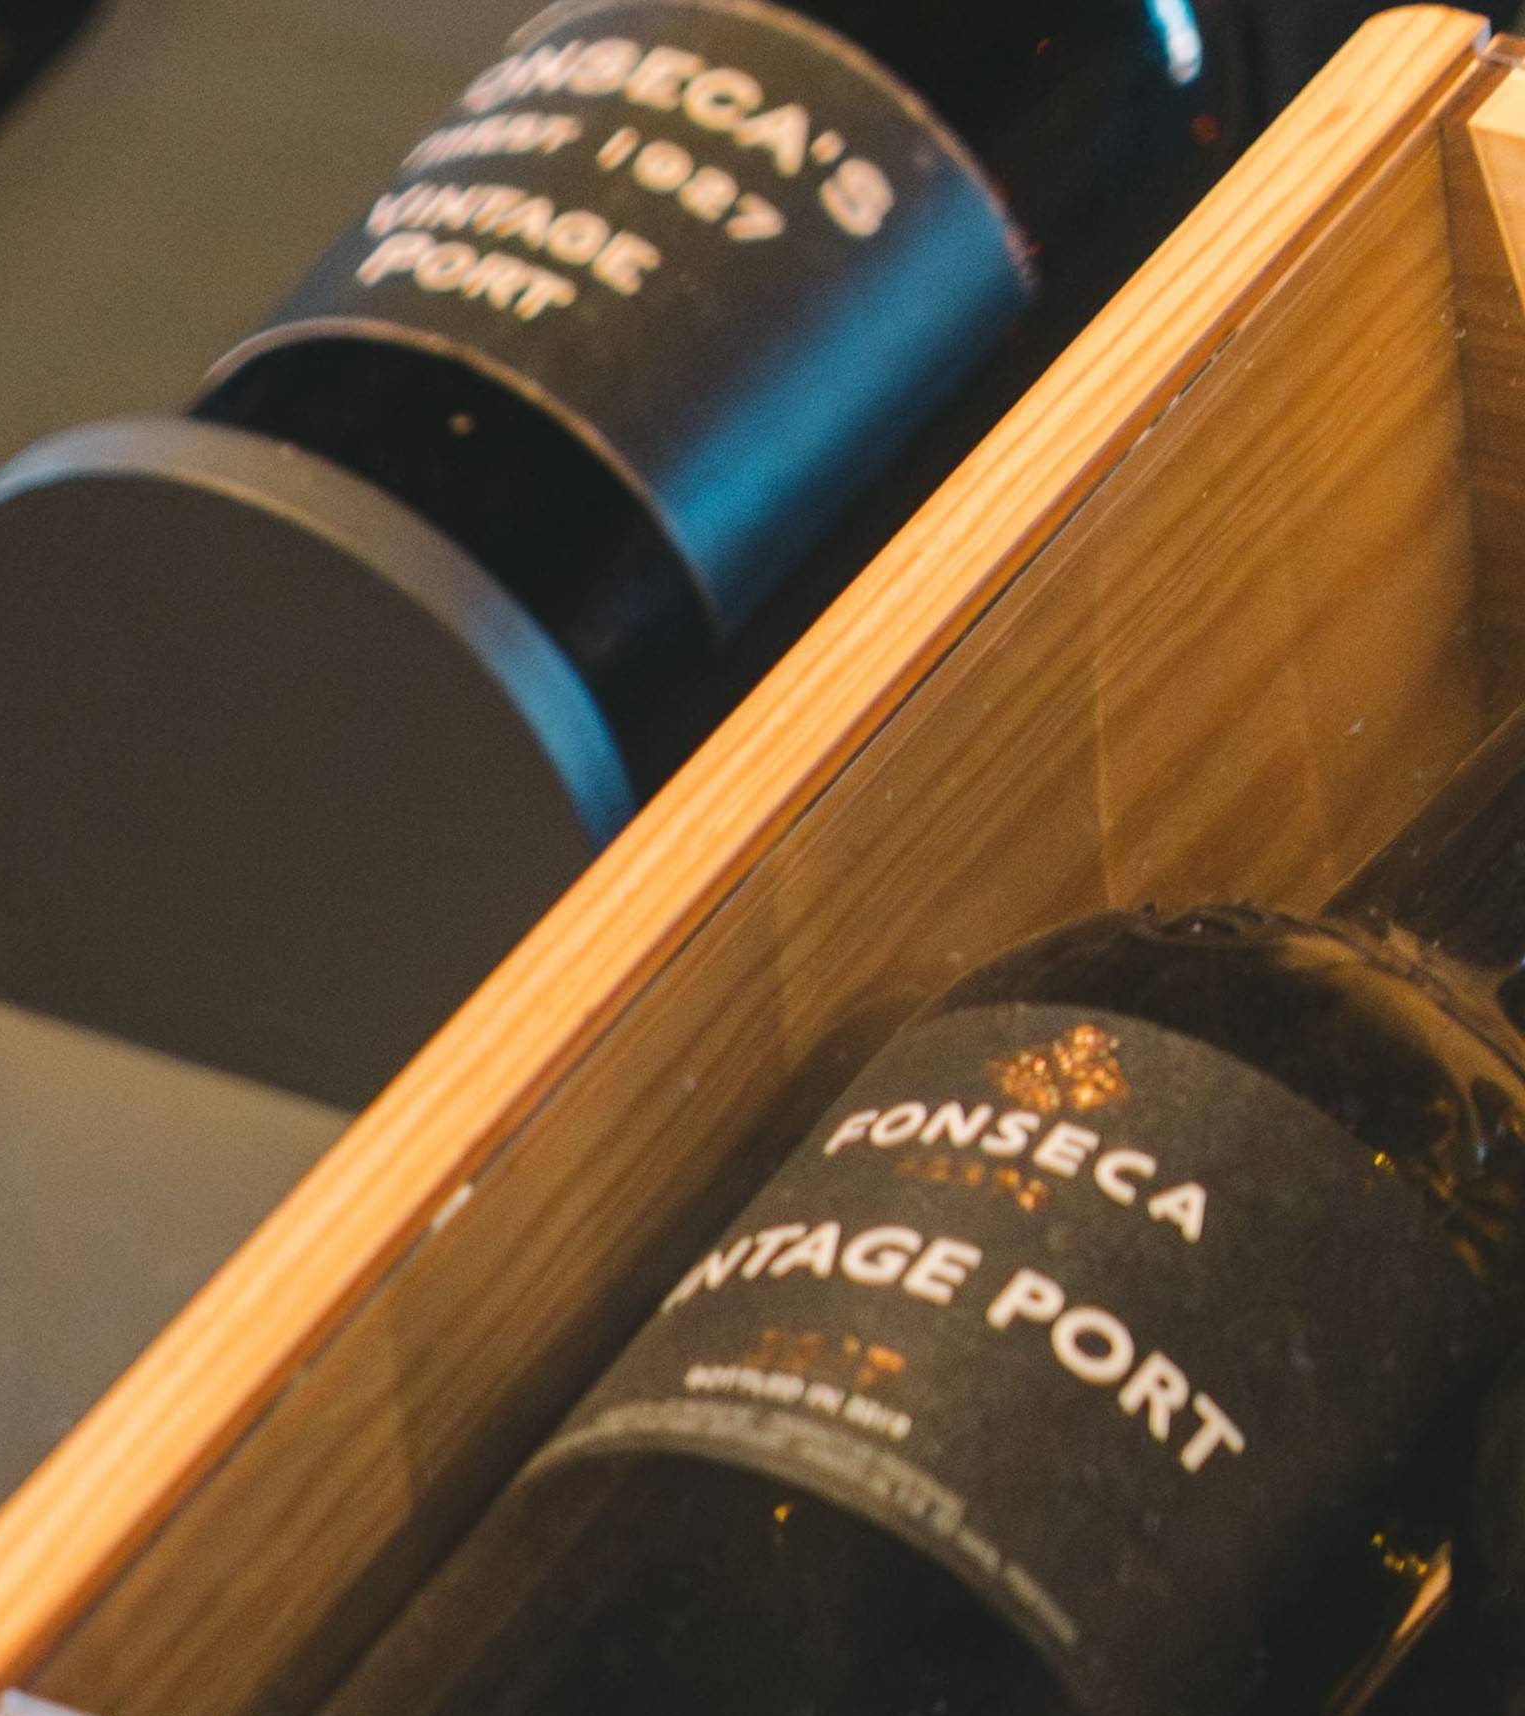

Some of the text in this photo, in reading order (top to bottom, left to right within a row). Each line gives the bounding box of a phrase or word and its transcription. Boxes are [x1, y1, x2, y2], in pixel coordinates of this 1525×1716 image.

[356, 231, 577, 321] PORT
[822, 1100, 1207, 1243] FONSECA
[660, 1220, 1246, 1474] NTAGE PORT
